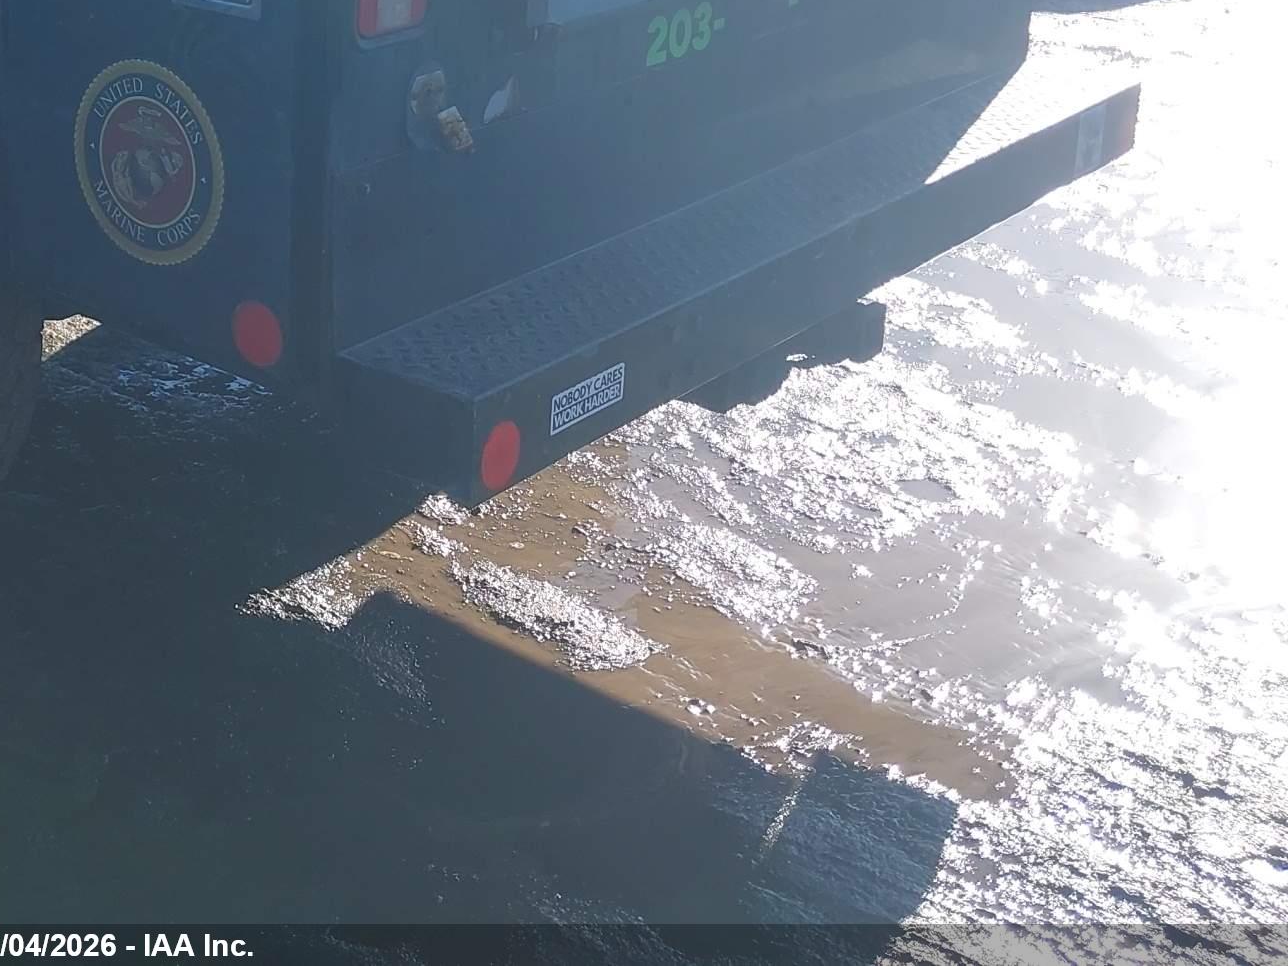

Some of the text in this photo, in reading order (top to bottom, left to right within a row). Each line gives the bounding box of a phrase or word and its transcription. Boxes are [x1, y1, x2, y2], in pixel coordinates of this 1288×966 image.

[93, 76, 204, 146] UNITED STATES
[94, 180, 202, 247] MARINE CORPS
[552, 384, 621, 432] WORK HARDER
[553, 367, 623, 413] NOBODY CARES
